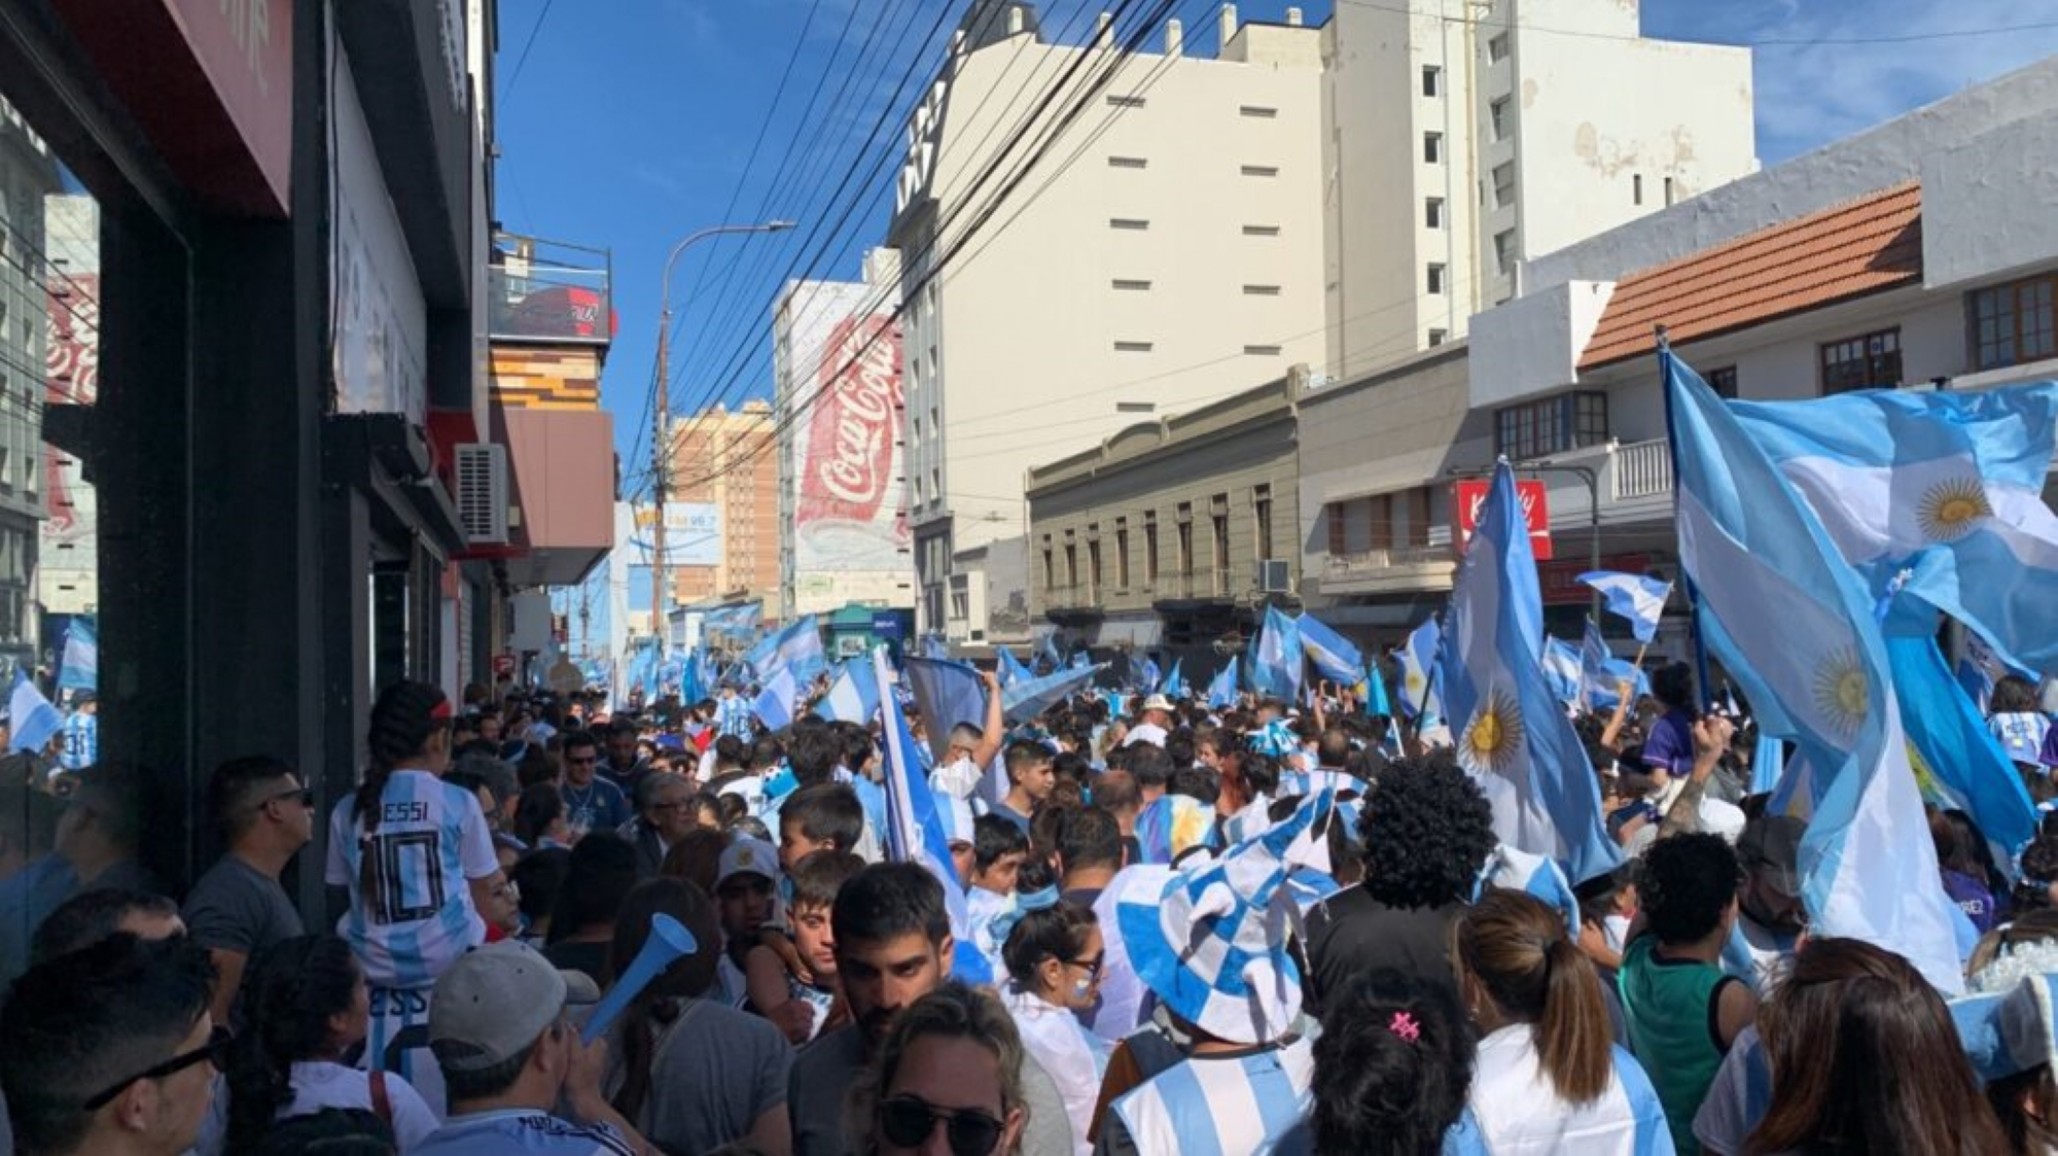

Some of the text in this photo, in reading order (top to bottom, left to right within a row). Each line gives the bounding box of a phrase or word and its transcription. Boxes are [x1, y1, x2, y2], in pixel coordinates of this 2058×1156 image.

[383, 801, 428, 821] ESSI
[358, 830, 445, 926] 10
[369, 986, 427, 1017] ESS
